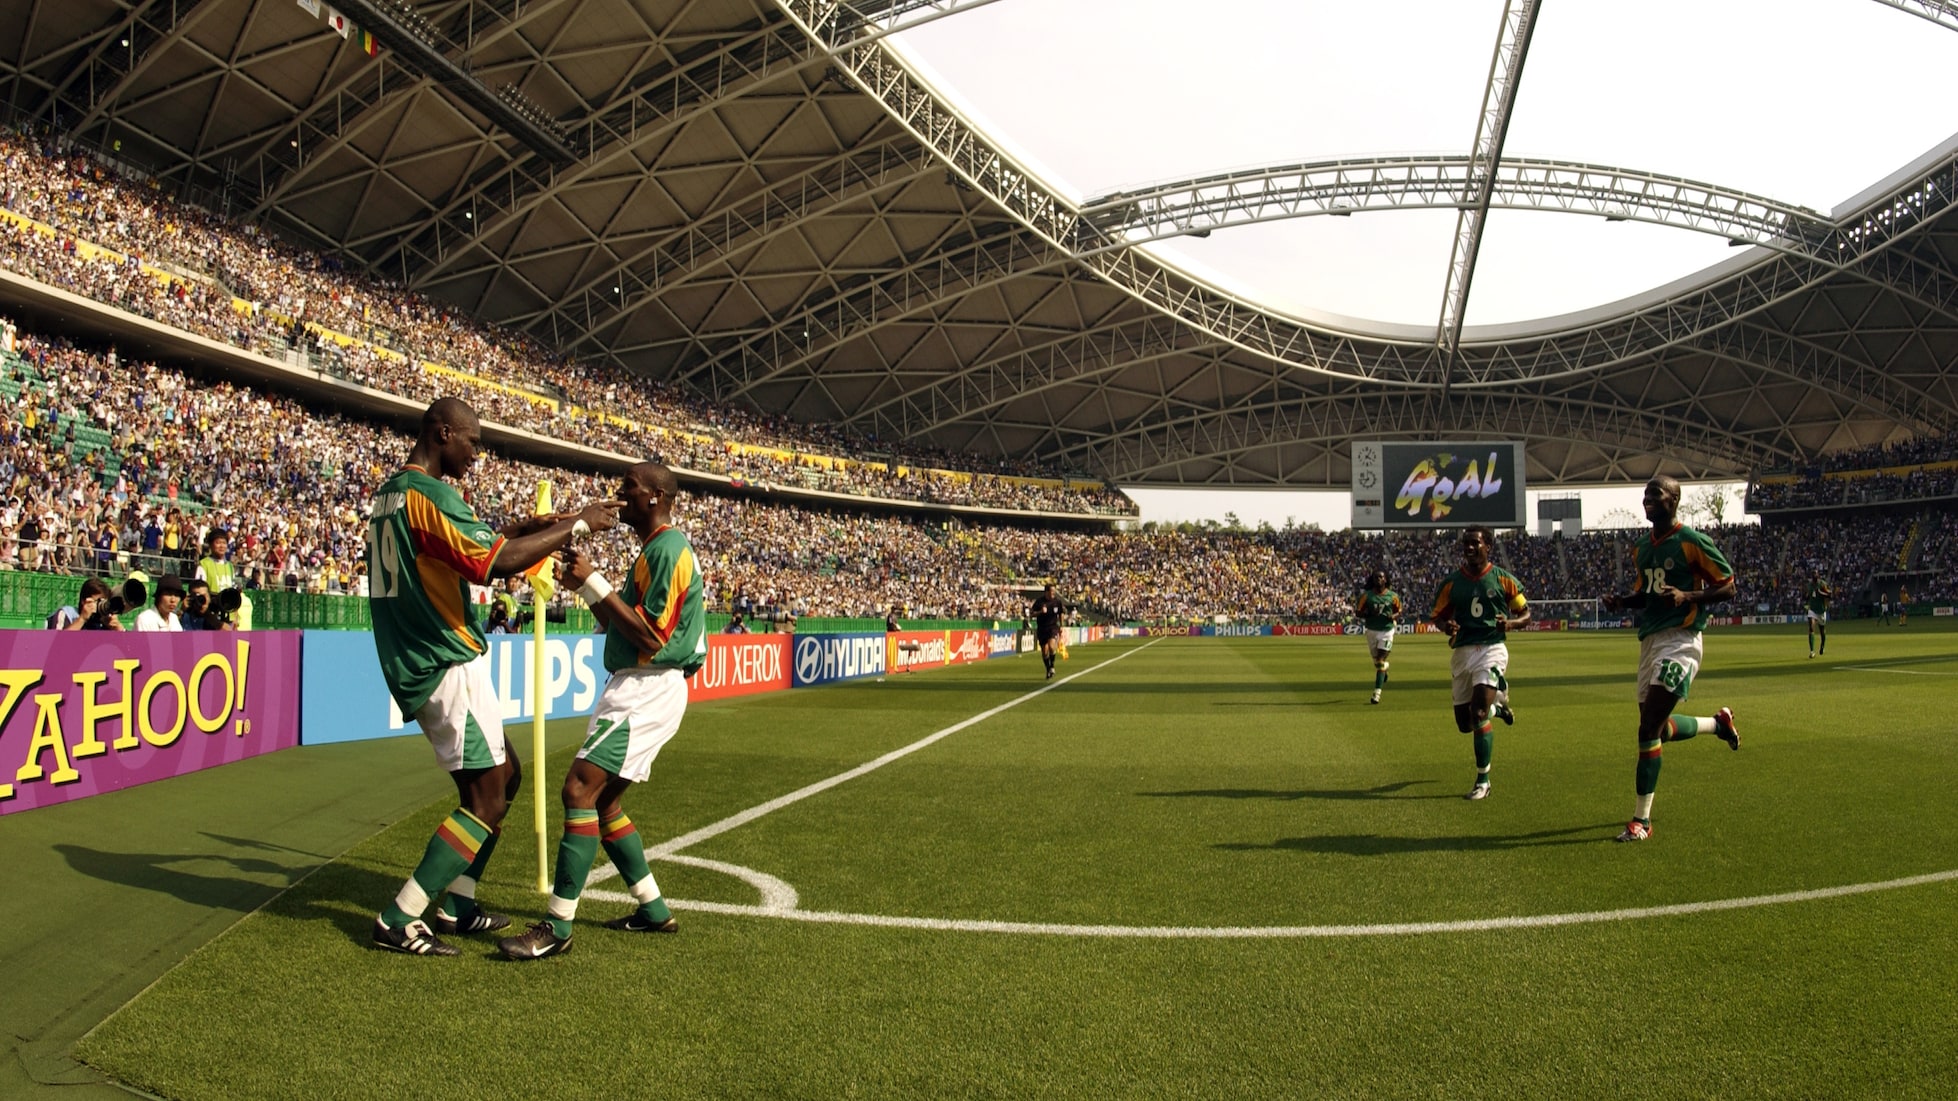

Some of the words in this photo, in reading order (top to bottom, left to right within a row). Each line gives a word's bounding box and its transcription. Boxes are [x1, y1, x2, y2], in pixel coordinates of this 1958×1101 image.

[367, 519, 399, 597] 19
[1644, 567, 1667, 594] 18
[1470, 596, 1484, 618] 6
[1146, 626, 1190, 636] YAHOO!
[1214, 625, 1261, 636] PHILIPS
[1310, 626, 1336, 635] XEROX
[732, 643, 782, 684] XEROX
[823, 636, 886, 679] HYUNDAI
[1657, 658, 1684, 689] 18
[582, 717, 616, 750] 7
